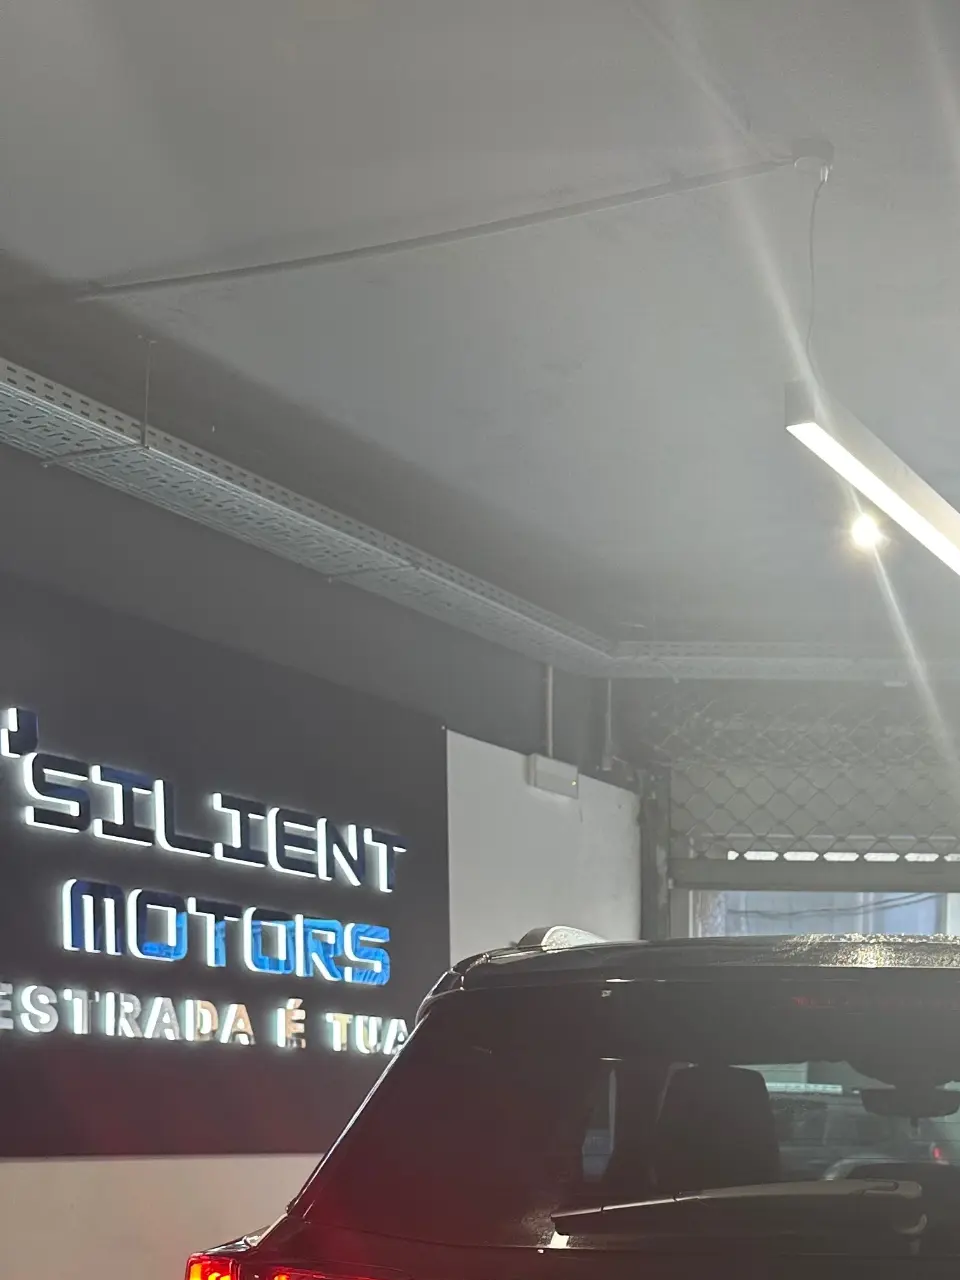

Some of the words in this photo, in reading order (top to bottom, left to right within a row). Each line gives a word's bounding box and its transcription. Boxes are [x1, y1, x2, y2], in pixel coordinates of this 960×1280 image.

[62, 877, 391, 985] MOTORS
[276, 998, 306, 1049] É
[326, 1012, 411, 1055] TUA
